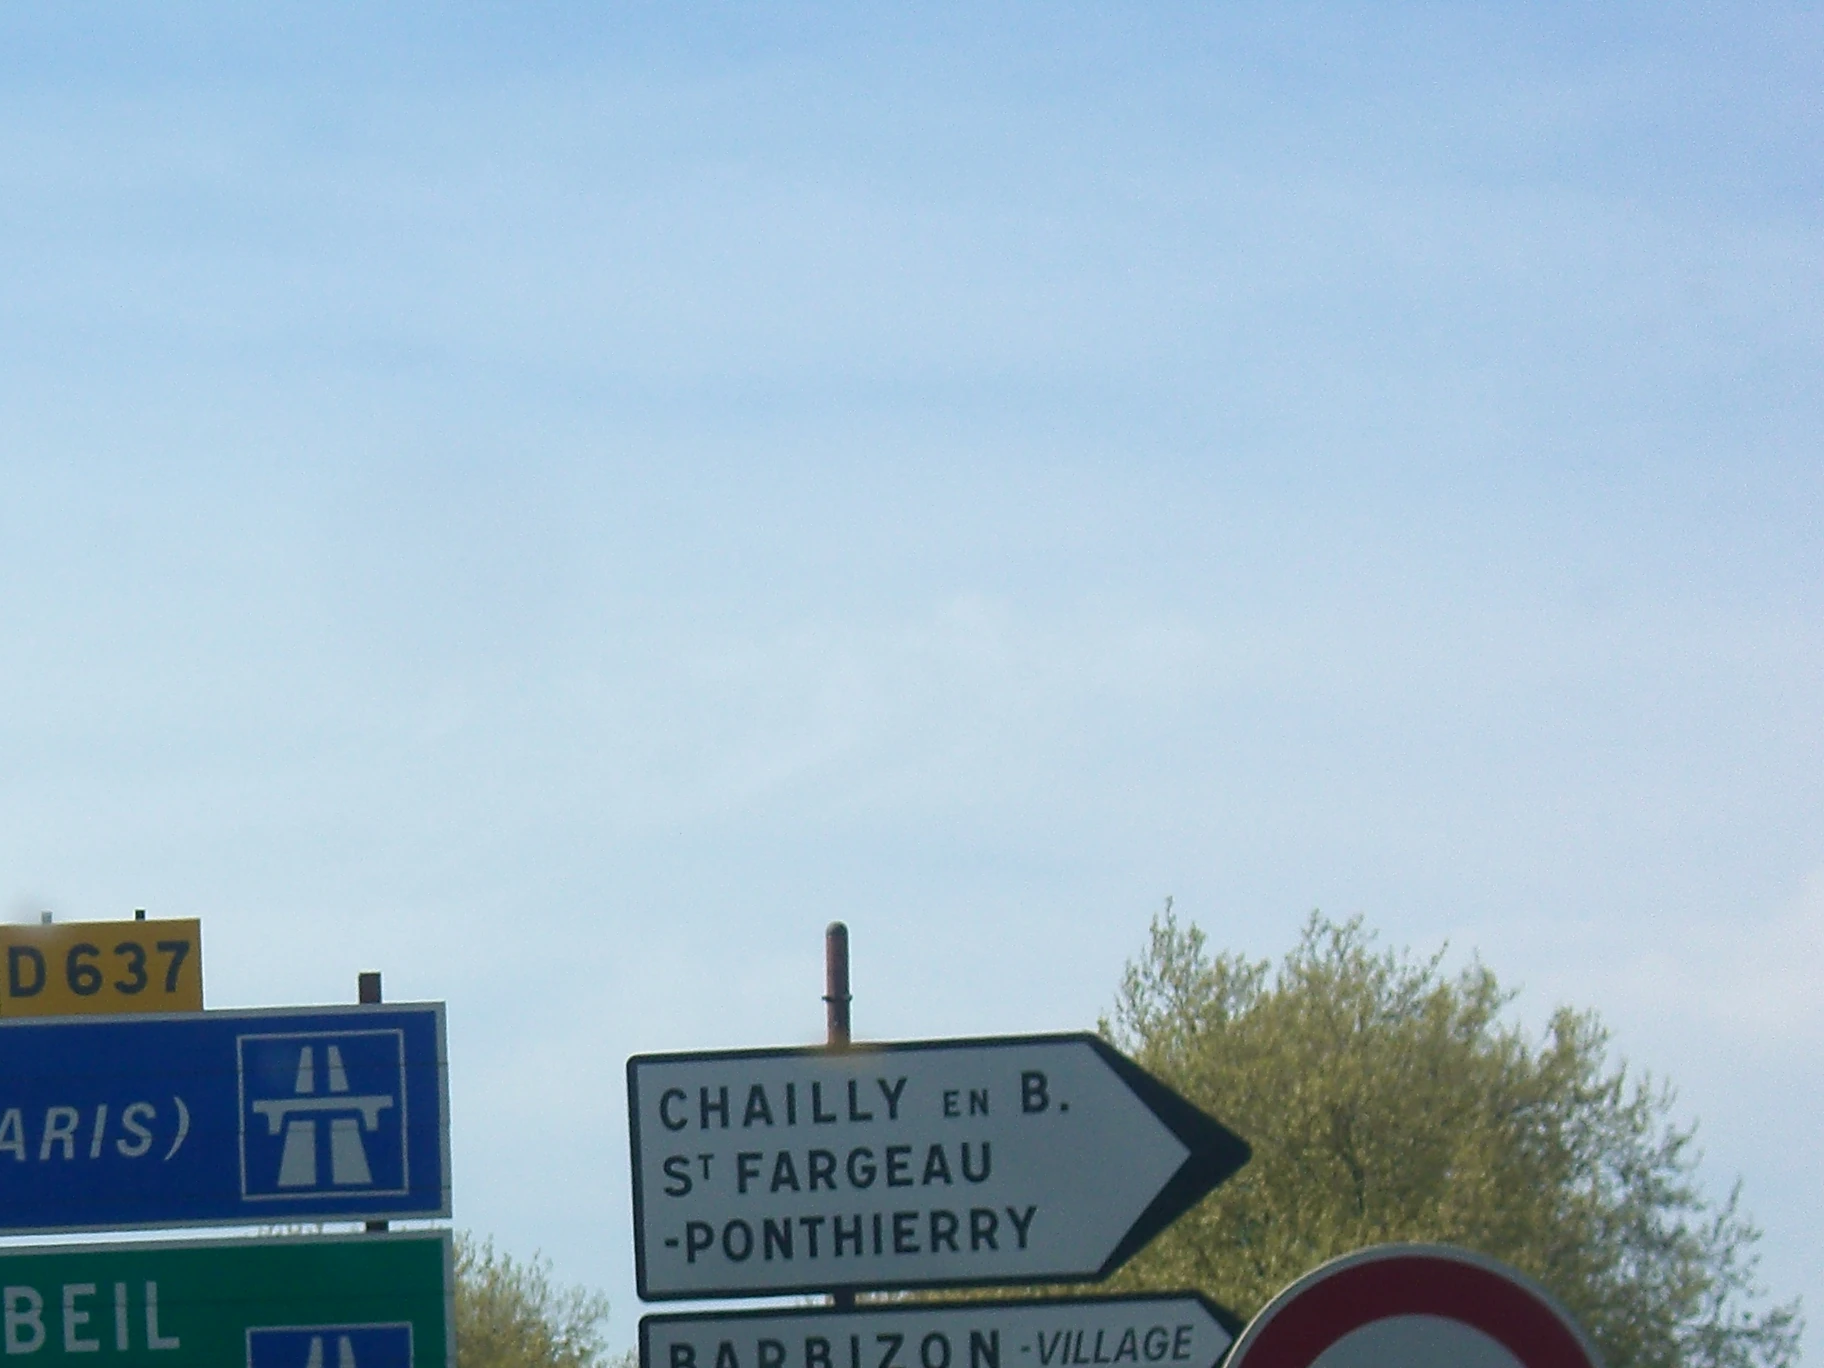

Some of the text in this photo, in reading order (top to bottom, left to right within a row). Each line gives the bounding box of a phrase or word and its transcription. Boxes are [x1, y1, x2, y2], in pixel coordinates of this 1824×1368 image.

[8, 939, 191, 998] D 637
[658, 1070, 1071, 1131] CHAILLY EN B.
[736, 1141, 993, 1194] FARGEAU
[664, 1205, 1038, 1264] -PONTHIERRY
